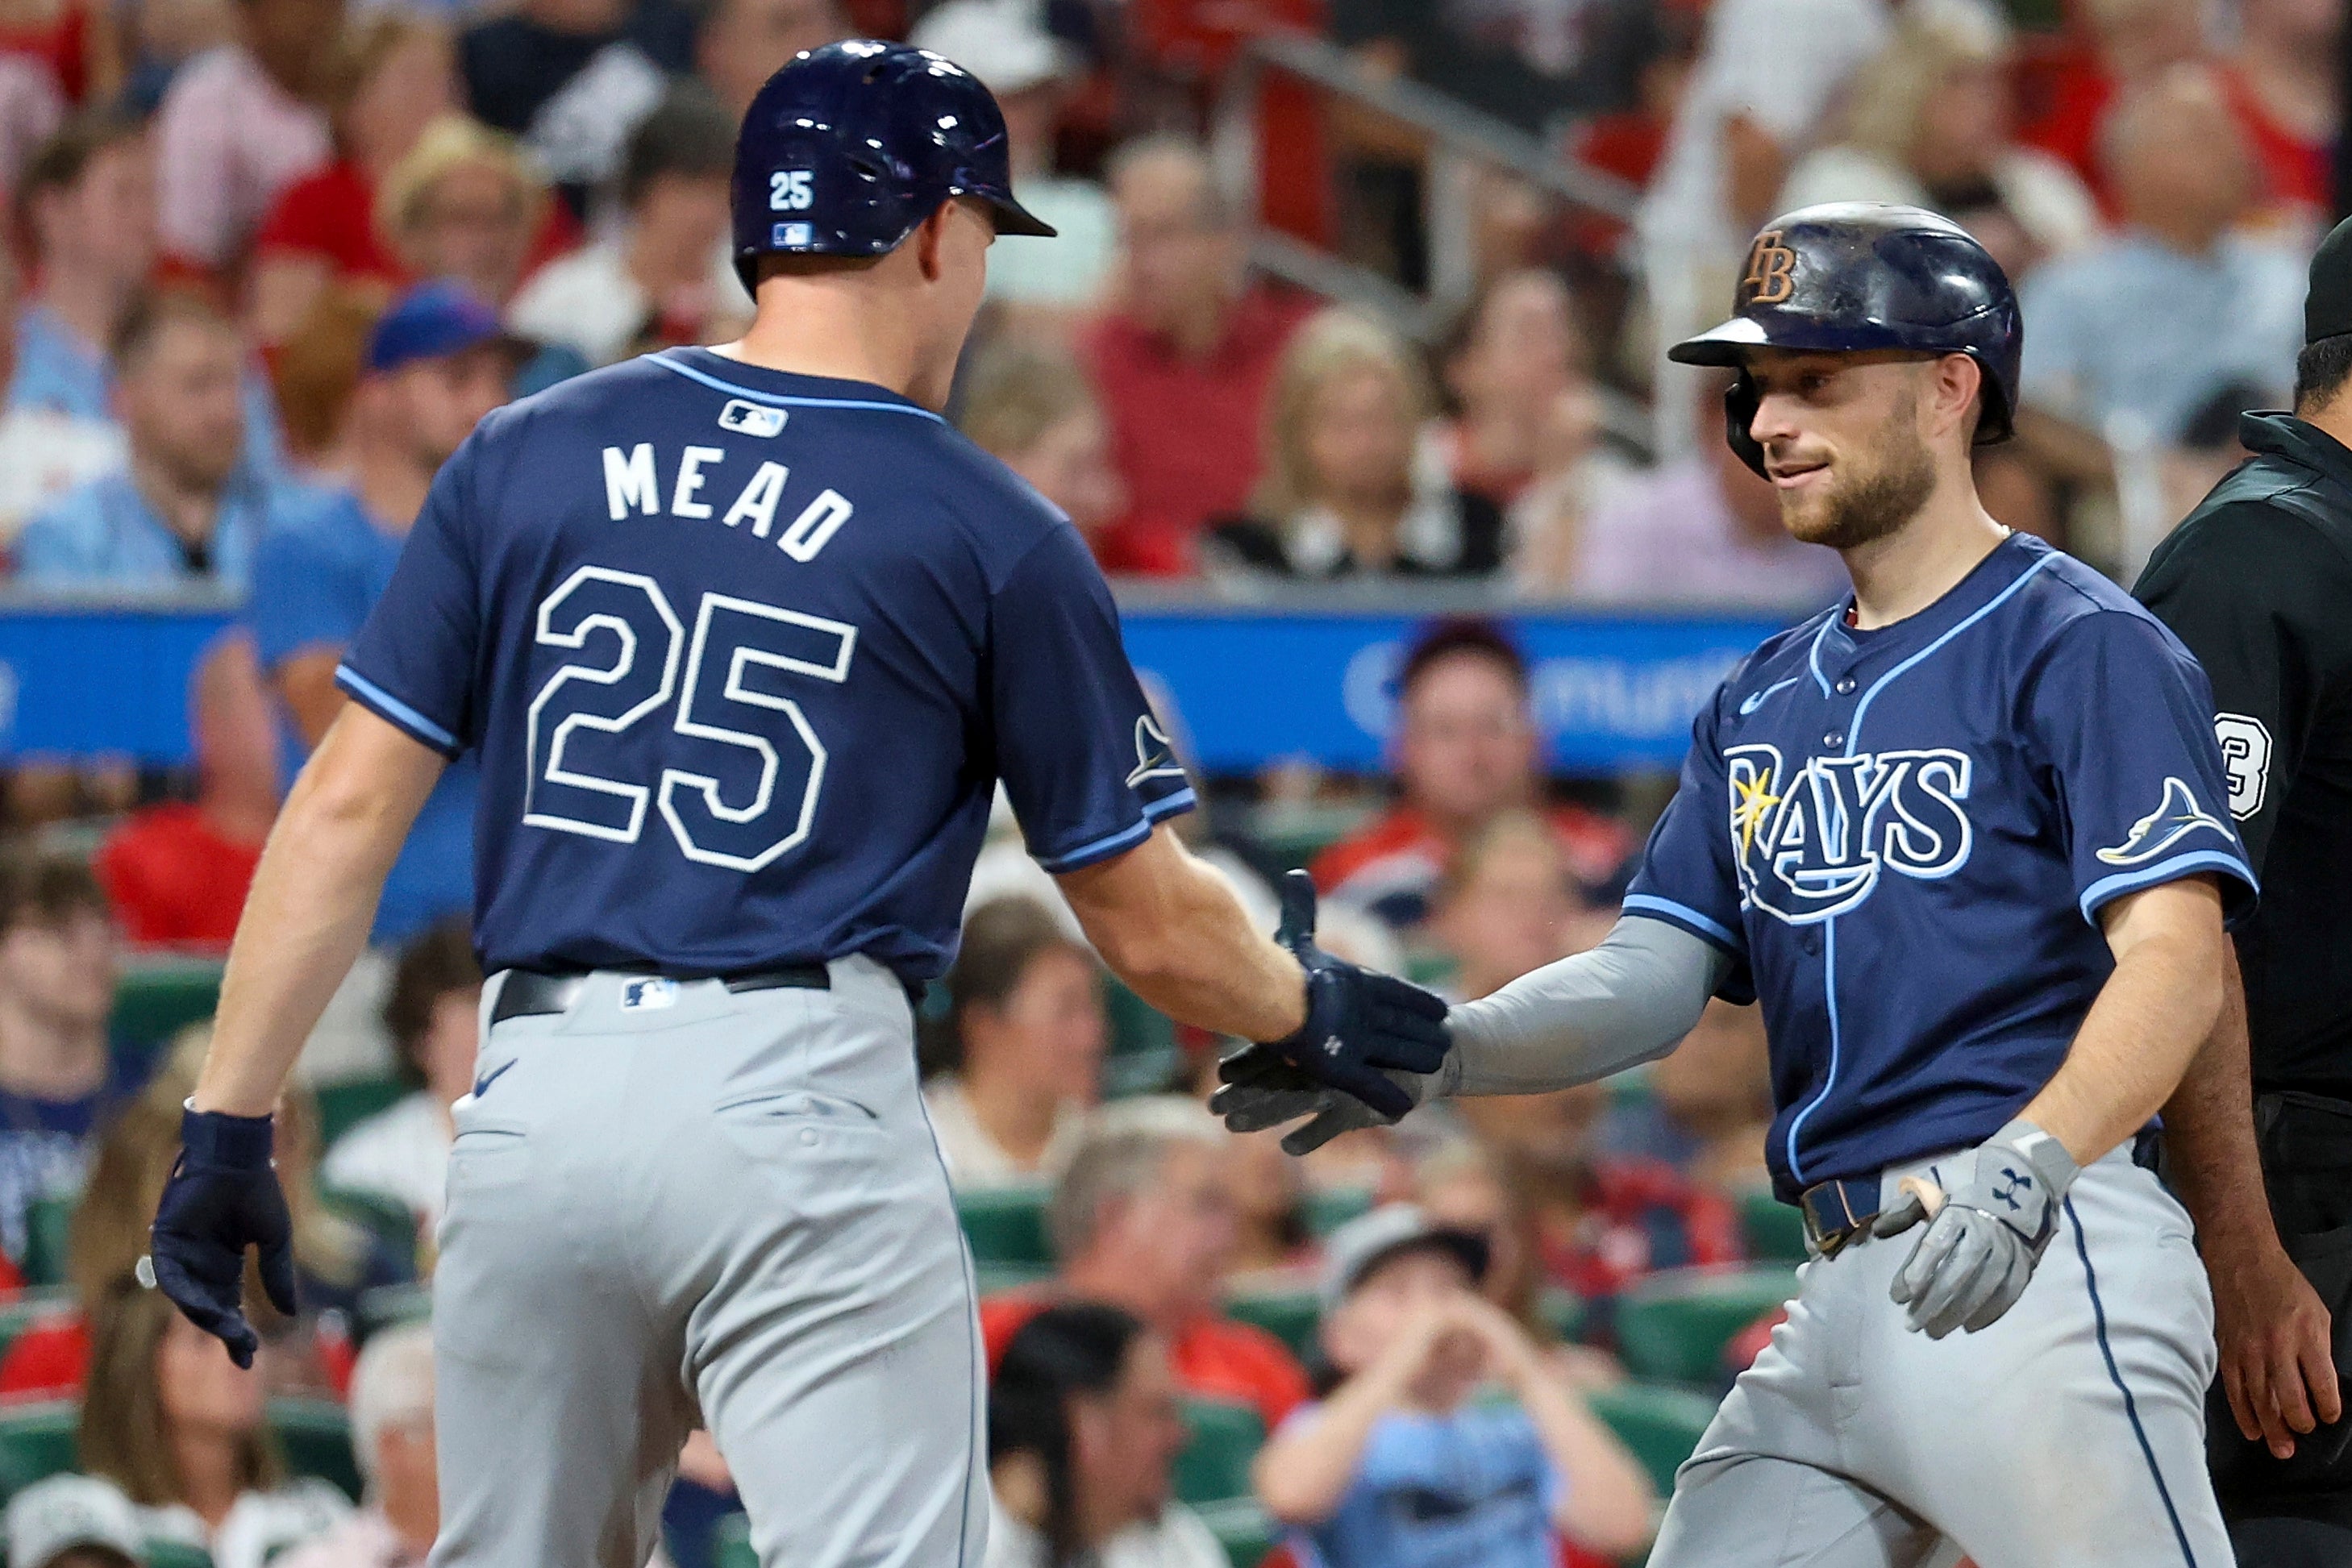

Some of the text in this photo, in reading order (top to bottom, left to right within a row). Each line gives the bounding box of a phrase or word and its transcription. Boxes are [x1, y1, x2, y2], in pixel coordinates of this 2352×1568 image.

[769, 169, 814, 210] 25
[1742, 229, 1796, 303] TB
[602, 442, 854, 563] MEAD
[522, 564, 860, 873] 25
[1722, 742, 1974, 927] RAYS
